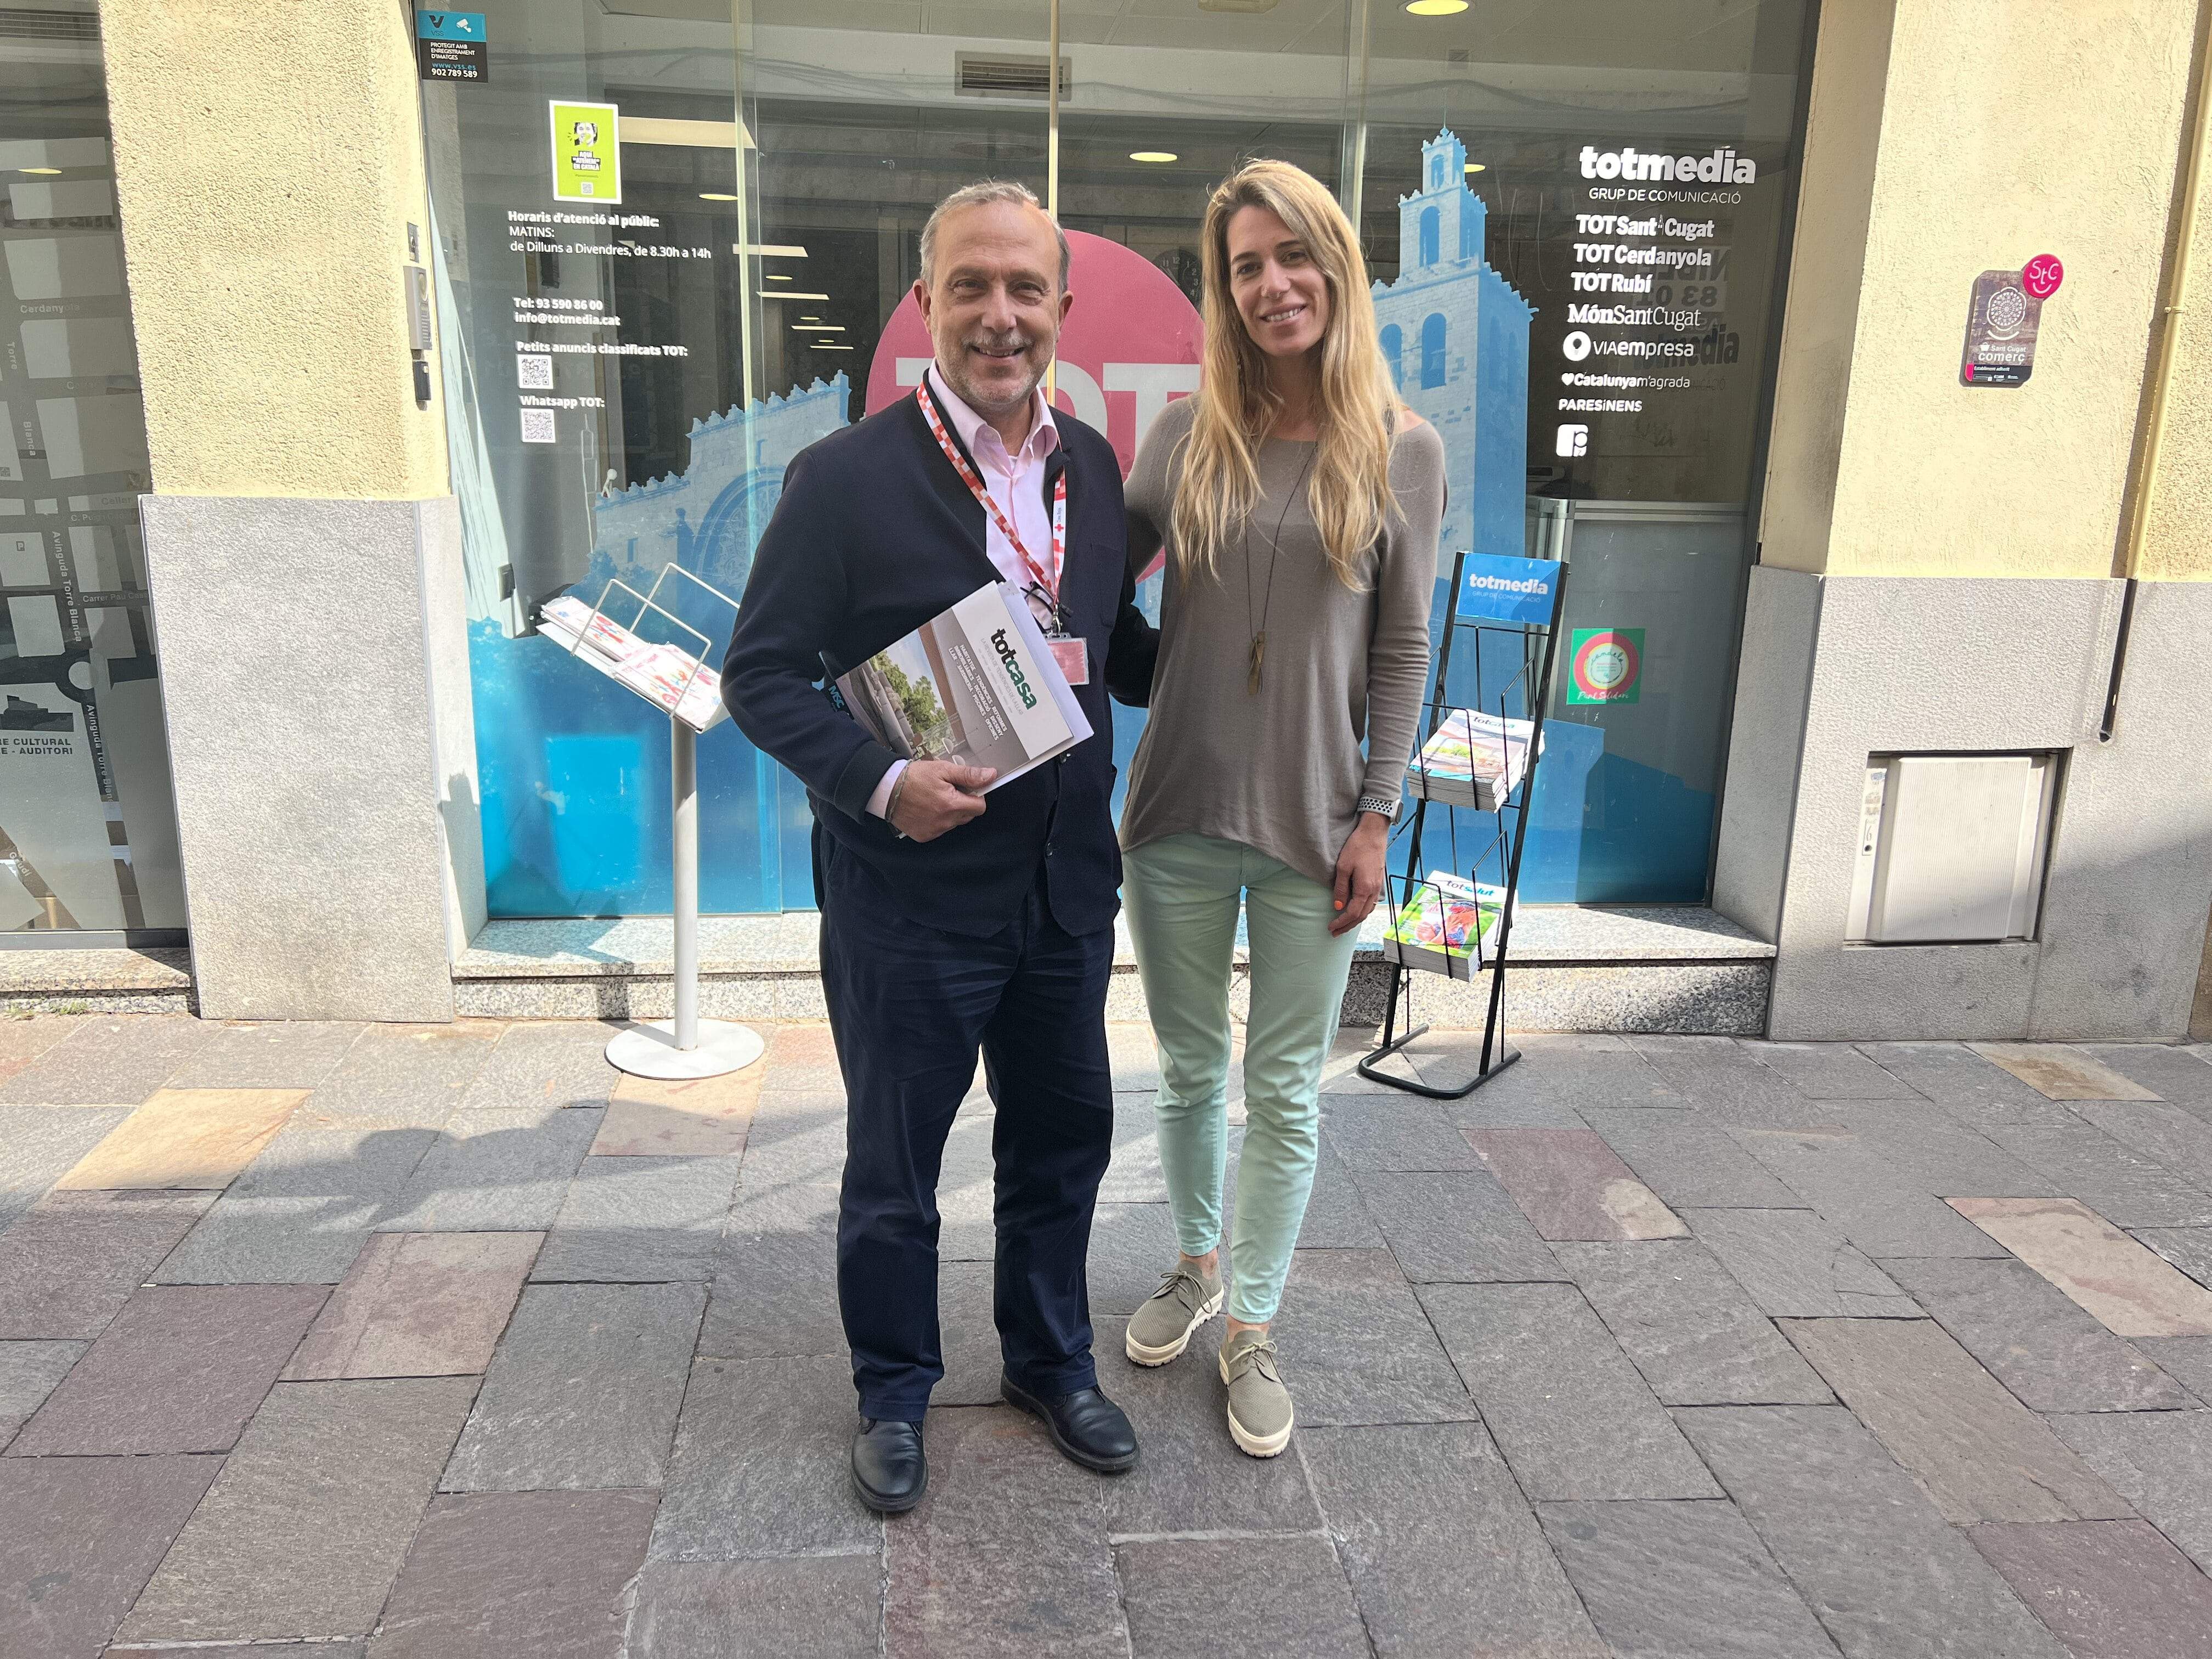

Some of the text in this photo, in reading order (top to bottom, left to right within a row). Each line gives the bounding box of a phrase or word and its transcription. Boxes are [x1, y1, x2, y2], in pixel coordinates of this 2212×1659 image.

[431, 68, 447, 76] 902
[463, 70, 478, 78] 589
[1579, 145, 1756, 184] totmedia
[1589, 187, 1741, 204] GRUP DE COMUNICACIÓ
[508, 211, 659, 228] Horaris d'atenció al públic:
[1576, 214, 1714, 241] TOT Sant Cugat
[509, 226, 555, 238] MATINS:
[511, 241, 711, 258] de Dilluns a Divendres, de 8.30h a 14h
[1573, 243, 1615, 262] TOT
[1615, 245, 1712, 269] Cerdanyola
[1571, 272, 1653, 293] TOT Rubí
[514, 297, 602, 311] Tel: 93 590 86 00
[515, 312, 620, 326] info@totmedia.cat
[1567, 303, 1701, 331] MónSantCugat
[517, 341, 688, 357] Petits anuncis classificats TOT:
[1593, 340, 1694, 359] VIAempresa
[1978, 352, 2025, 365] comerç
[7, 341, 36, 456] Torre Blanca
[520, 396, 605, 409] Whatsapp TOT:
[52, 531, 82, 642] Avinguda Torre Blanca
[1469, 574, 1548, 595] totmedia
[83, 594, 109, 603] Carrer
[1498, 593, 1541, 603] COMUNICACIÓ
[991, 628, 1037, 710] totcasa
[827, 685, 845, 708] MSC
[947, 647, 957, 661] LLAR
[956, 664, 974, 692] JARDINERIA
[972, 693, 987, 716] PISCINES
[984, 718, 1000, 741] OFICINES
[958, 644, 976, 672] HABITATGE
[974, 674, 994, 704] TENDÈNCIES
[991, 706, 1008, 731] REFORMES
[973, 684, 992, 712] DECORACIÓ
[989, 715, 1004, 737] DISSENY
[86, 704, 101, 748] Avinguda
